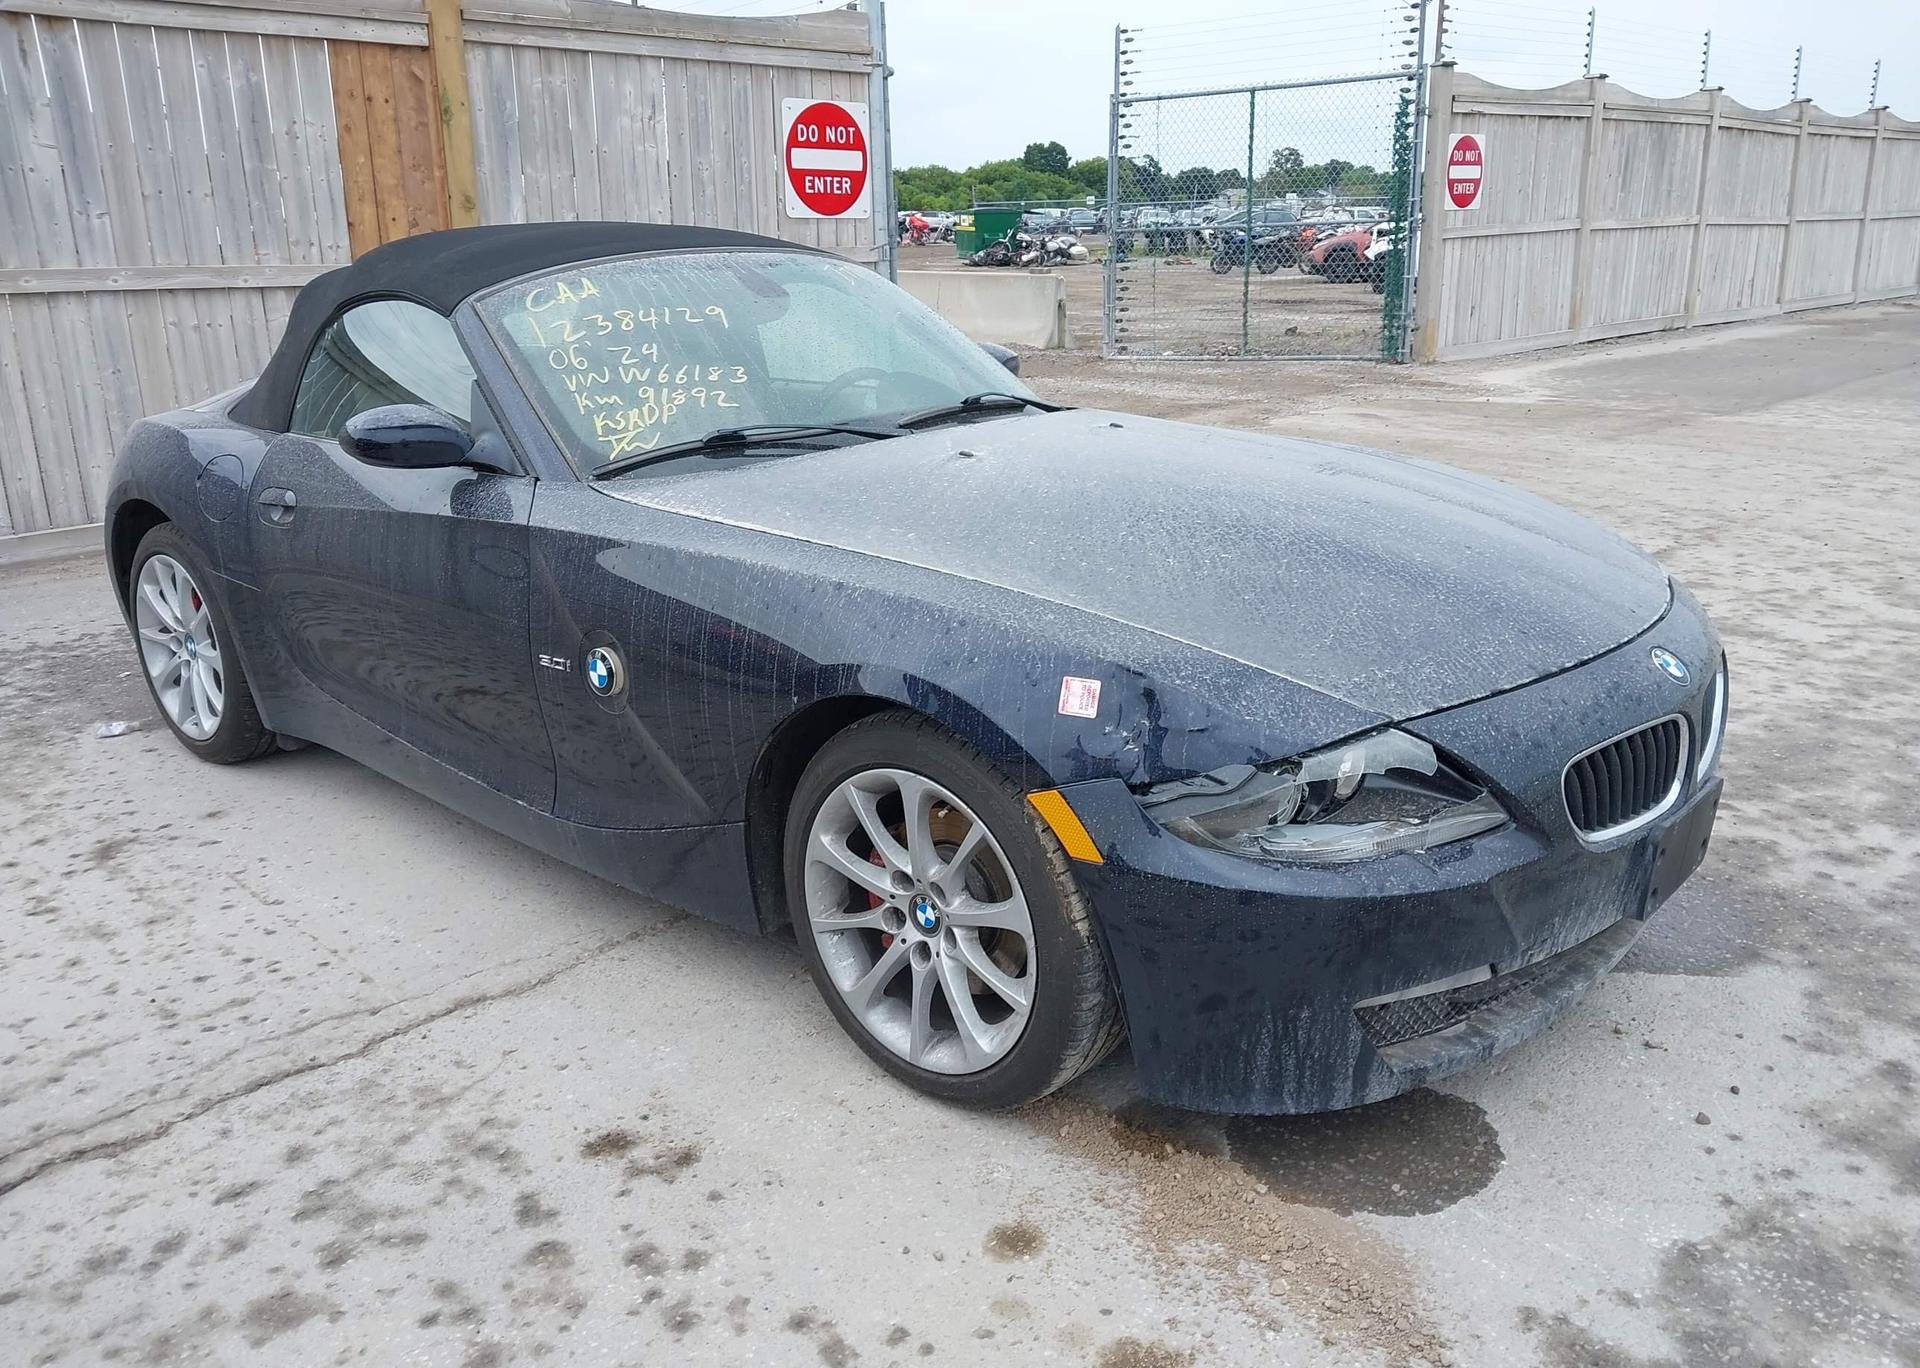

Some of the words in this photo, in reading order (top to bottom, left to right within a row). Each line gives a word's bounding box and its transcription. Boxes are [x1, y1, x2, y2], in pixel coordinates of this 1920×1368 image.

[797, 124, 818, 142] DO
[826, 126, 855, 144] NOT
[1453, 150, 1463, 161] DO
[1466, 150, 1480, 161] NOT
[805, 176, 851, 194] ENTER
[1453, 183, 1475, 195] ENTER
[526, 277, 600, 313] CAA
[527, 305, 729, 349] 12384129
[562, 366, 610, 392] VIN
[638, 386, 741, 408] 91892
